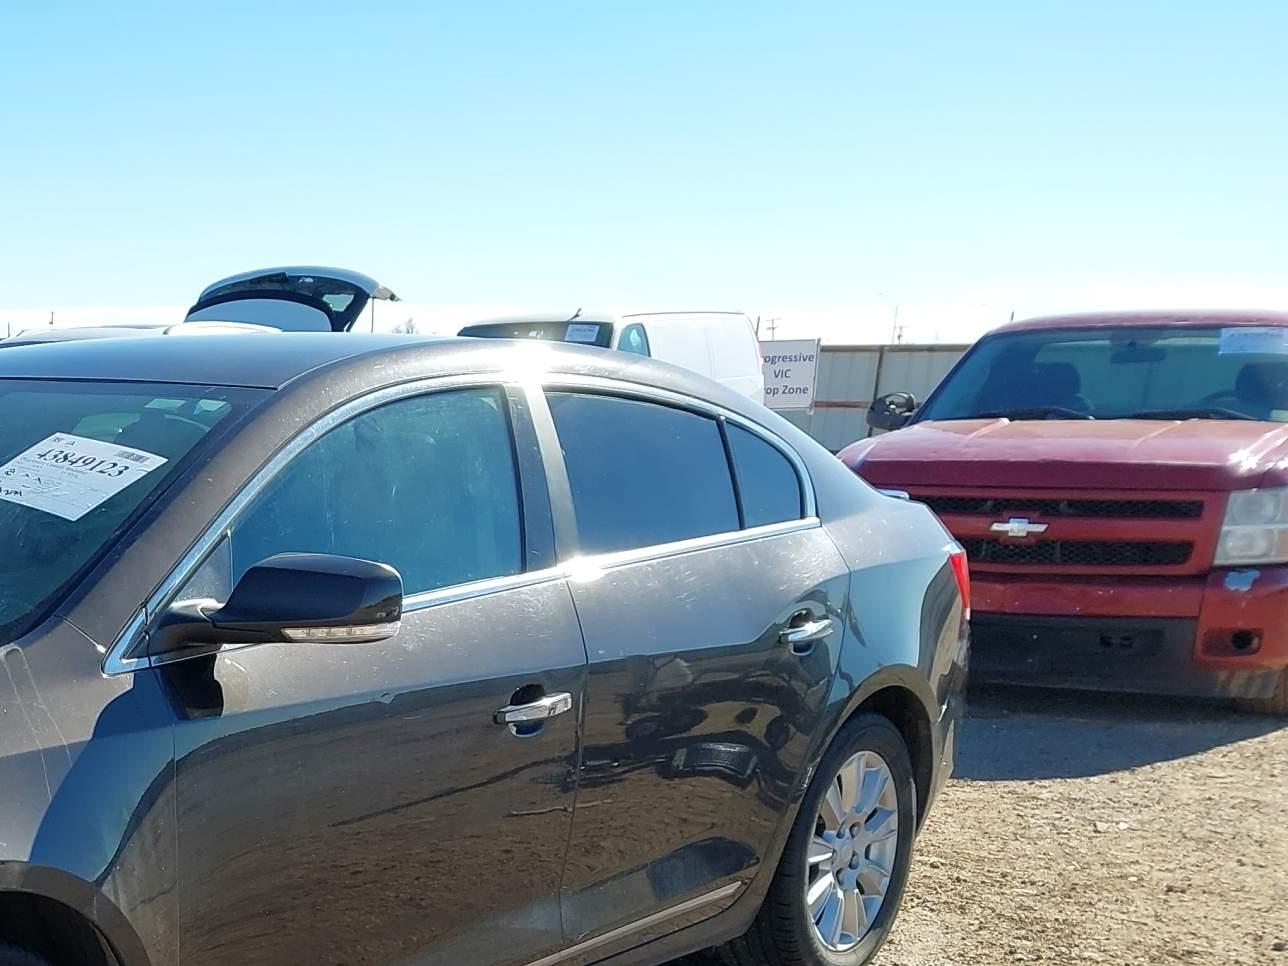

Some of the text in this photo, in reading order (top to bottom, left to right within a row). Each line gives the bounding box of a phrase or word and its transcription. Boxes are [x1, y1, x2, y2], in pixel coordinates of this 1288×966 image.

[762, 353, 814, 365] ogressive
[773, 369, 792, 379] VIC
[781, 385, 809, 395] Zone
[36, 448, 130, 477] 43849123
